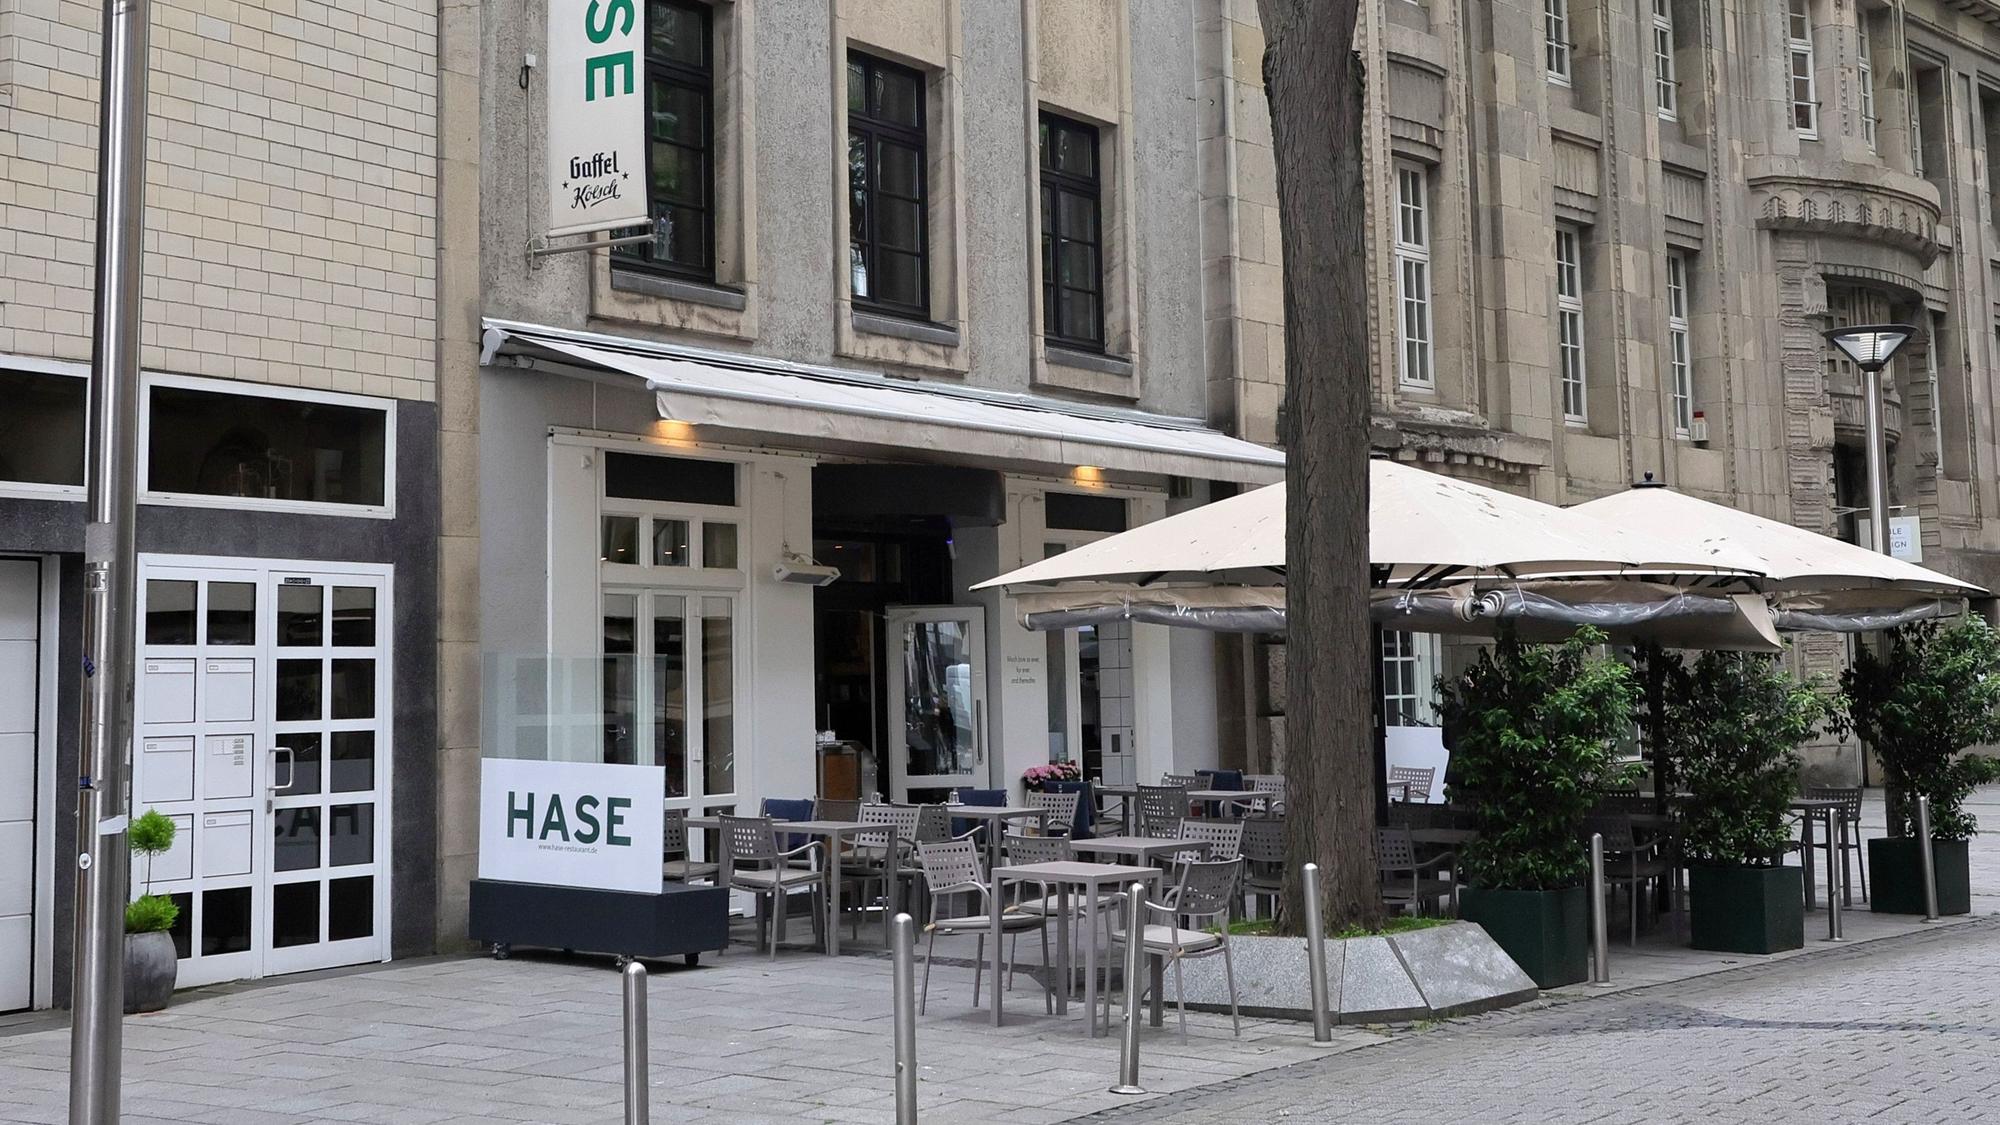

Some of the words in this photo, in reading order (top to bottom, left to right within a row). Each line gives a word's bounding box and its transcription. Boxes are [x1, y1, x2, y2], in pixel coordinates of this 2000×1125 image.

[570, 151, 619, 179] Gaffel
[571, 179, 621, 209] Kölsch
[507, 791, 632, 846] HASE
[538, 844, 598, 854] www.hase-restaurant.de
